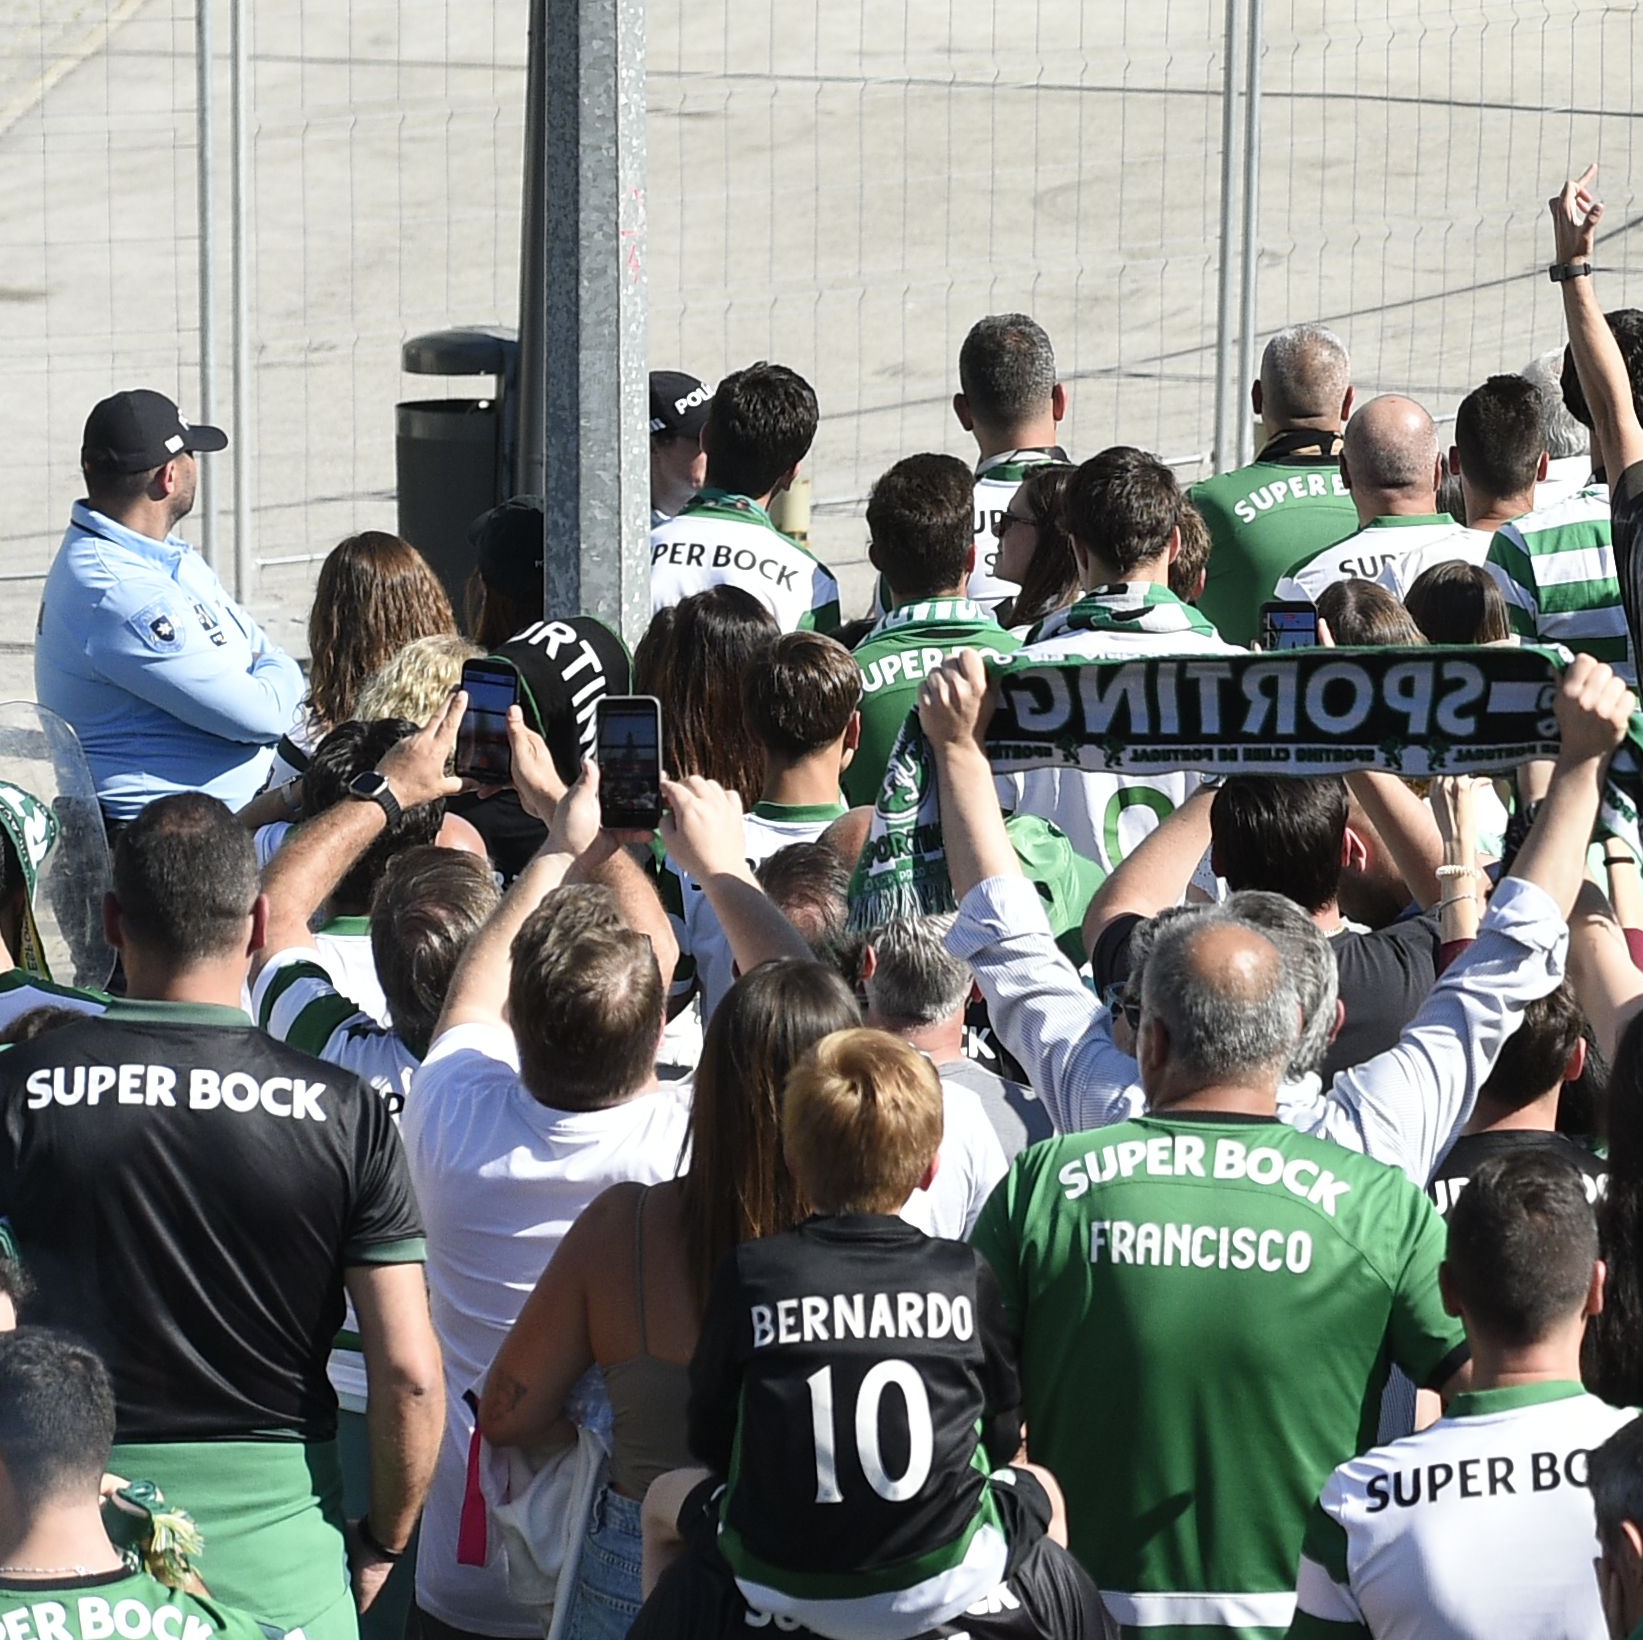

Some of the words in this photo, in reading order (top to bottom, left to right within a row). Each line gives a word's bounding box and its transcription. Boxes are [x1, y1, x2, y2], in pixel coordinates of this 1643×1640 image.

[1233, 473, 1327, 524] SUPER
[651, 543, 703, 567] PER
[712, 545, 799, 593] BOCK
[858, 649, 944, 692] UPER
[25, 1064, 177, 1111] SUPER
[188, 1068, 327, 1123] BOCK
[1057, 1135, 1208, 1202] SUPER
[1214, 1137, 1352, 1216] BOCK
[1090, 1220, 1313, 1275] FRANCISCO
[753, 1291, 974, 1349] BERNARDO
[806, 1360, 935, 1504] 10
[1365, 1454, 1516, 1512] SUPER
[1531, 1448, 1591, 1492] BO
